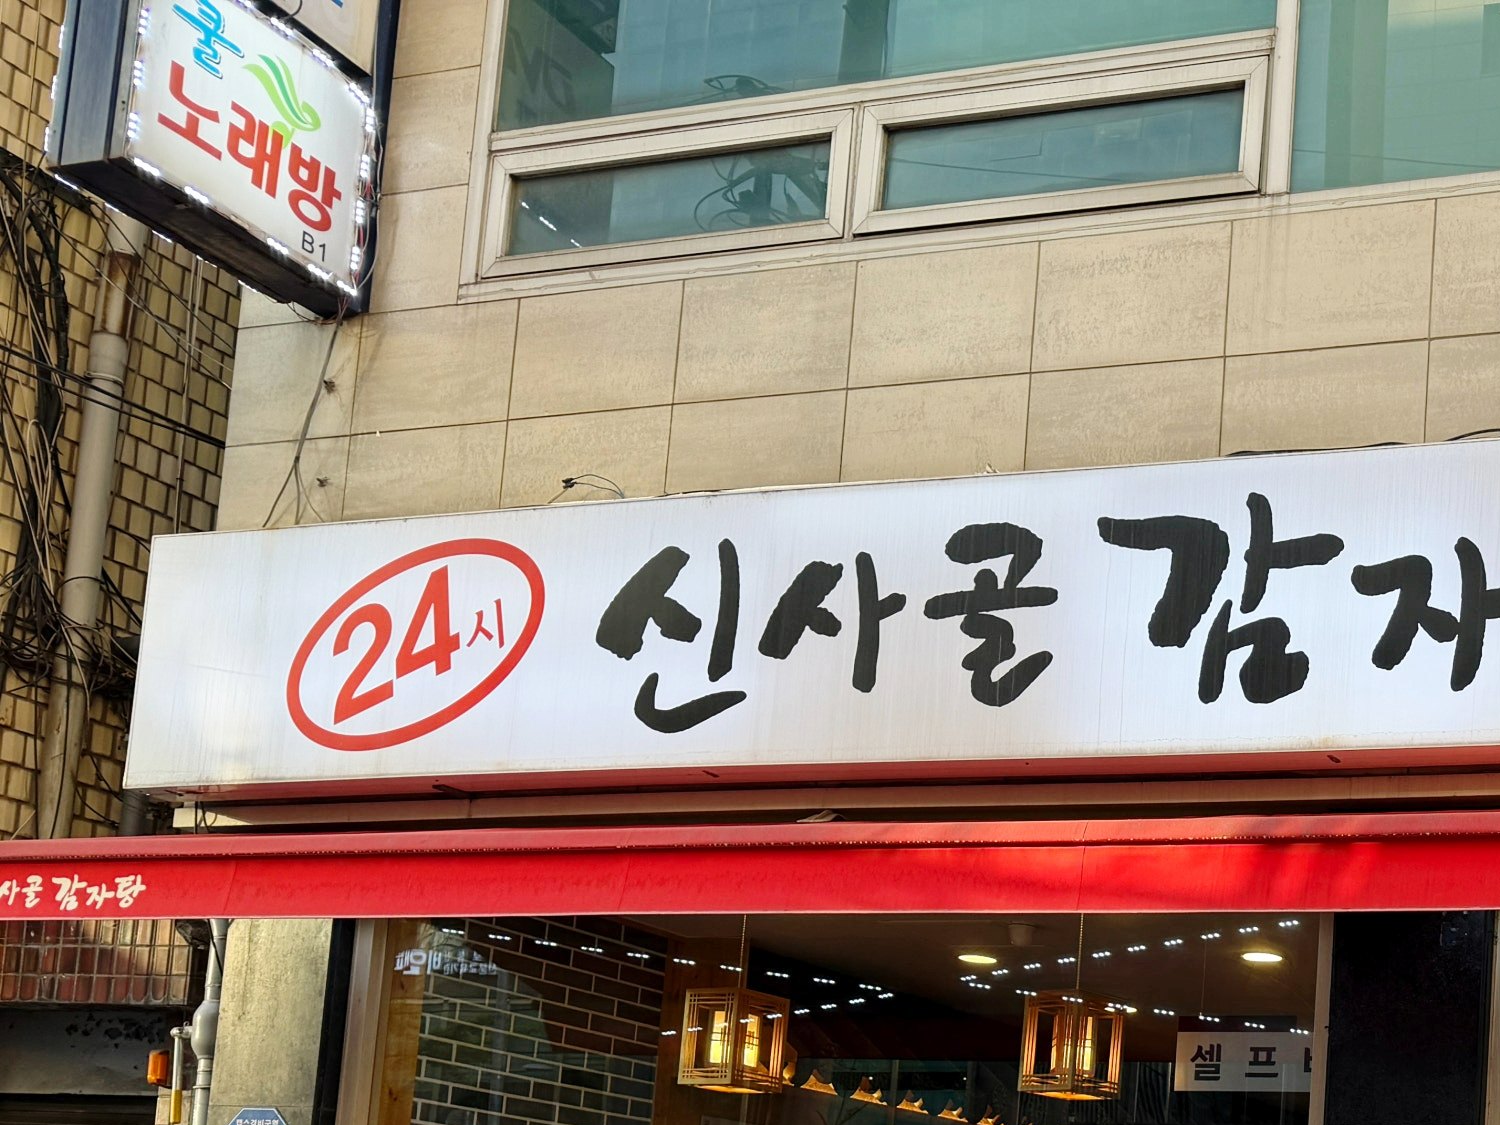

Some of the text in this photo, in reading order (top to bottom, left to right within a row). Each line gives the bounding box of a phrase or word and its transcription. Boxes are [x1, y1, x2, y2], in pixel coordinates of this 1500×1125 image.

[172, 0, 245, 79] 쿨
[158, 60, 342, 232] 노래방
[301, 230, 328, 263] B1
[332, 563, 506, 725] 24시
[595, 522, 1059, 734] 신사골
[52, 874, 147, 911] 감자탕
